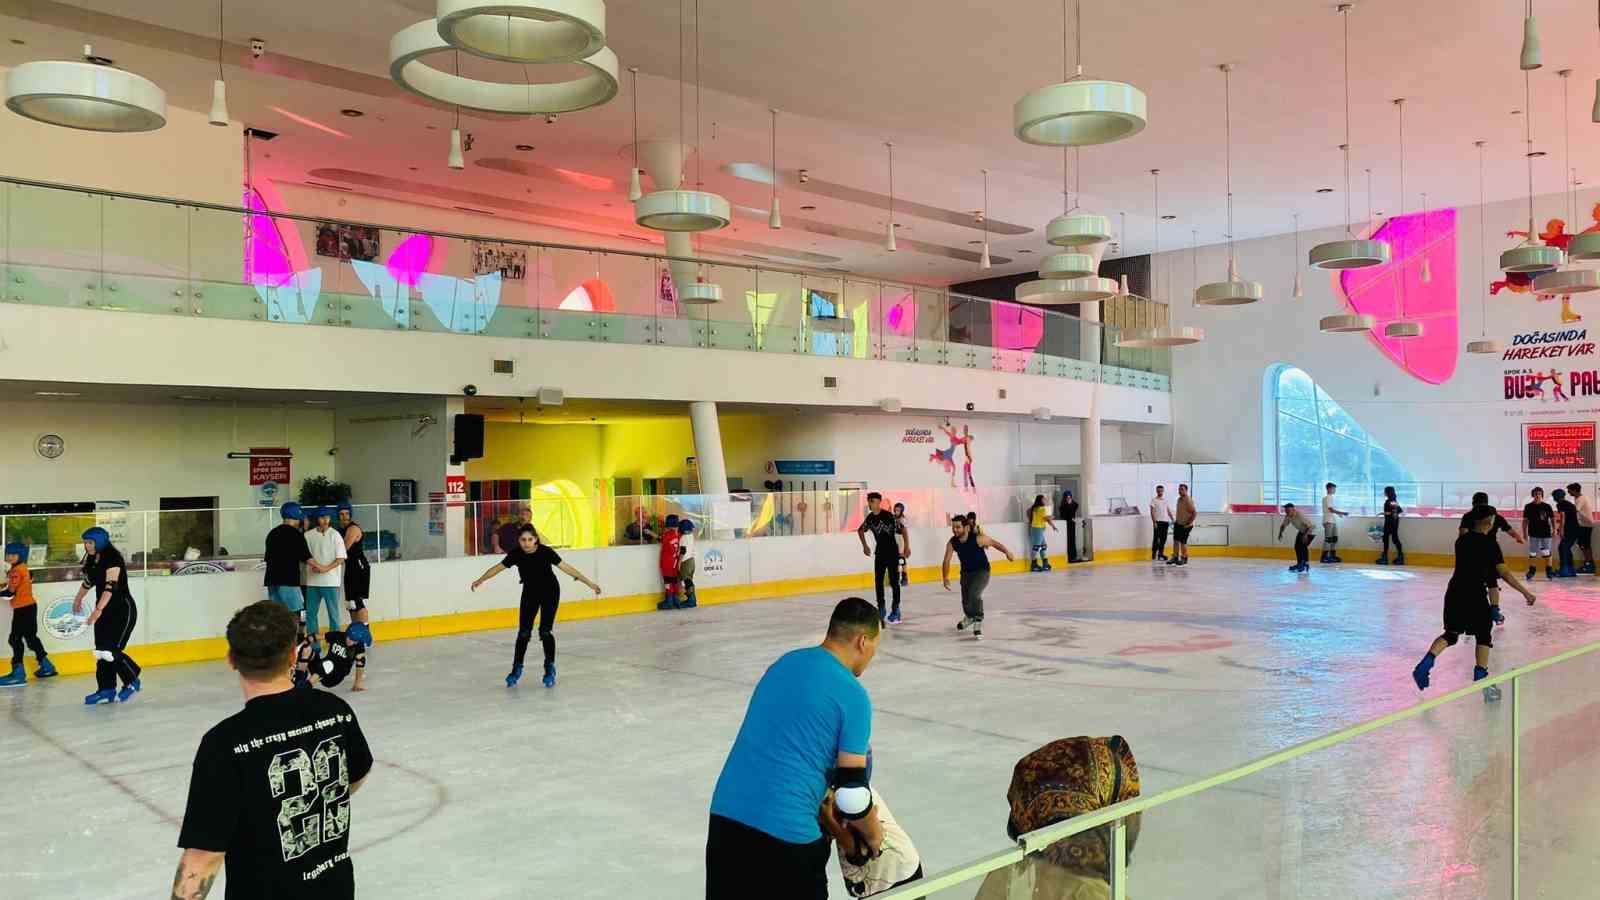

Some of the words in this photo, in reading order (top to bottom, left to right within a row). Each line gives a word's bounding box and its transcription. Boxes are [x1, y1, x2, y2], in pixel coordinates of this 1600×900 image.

[1513, 329, 1586, 345] DOĞASINDA
[1502, 346, 1567, 361] HAREKET
[1568, 342, 1595, 357] VAR
[448, 481, 464, 493] 112
